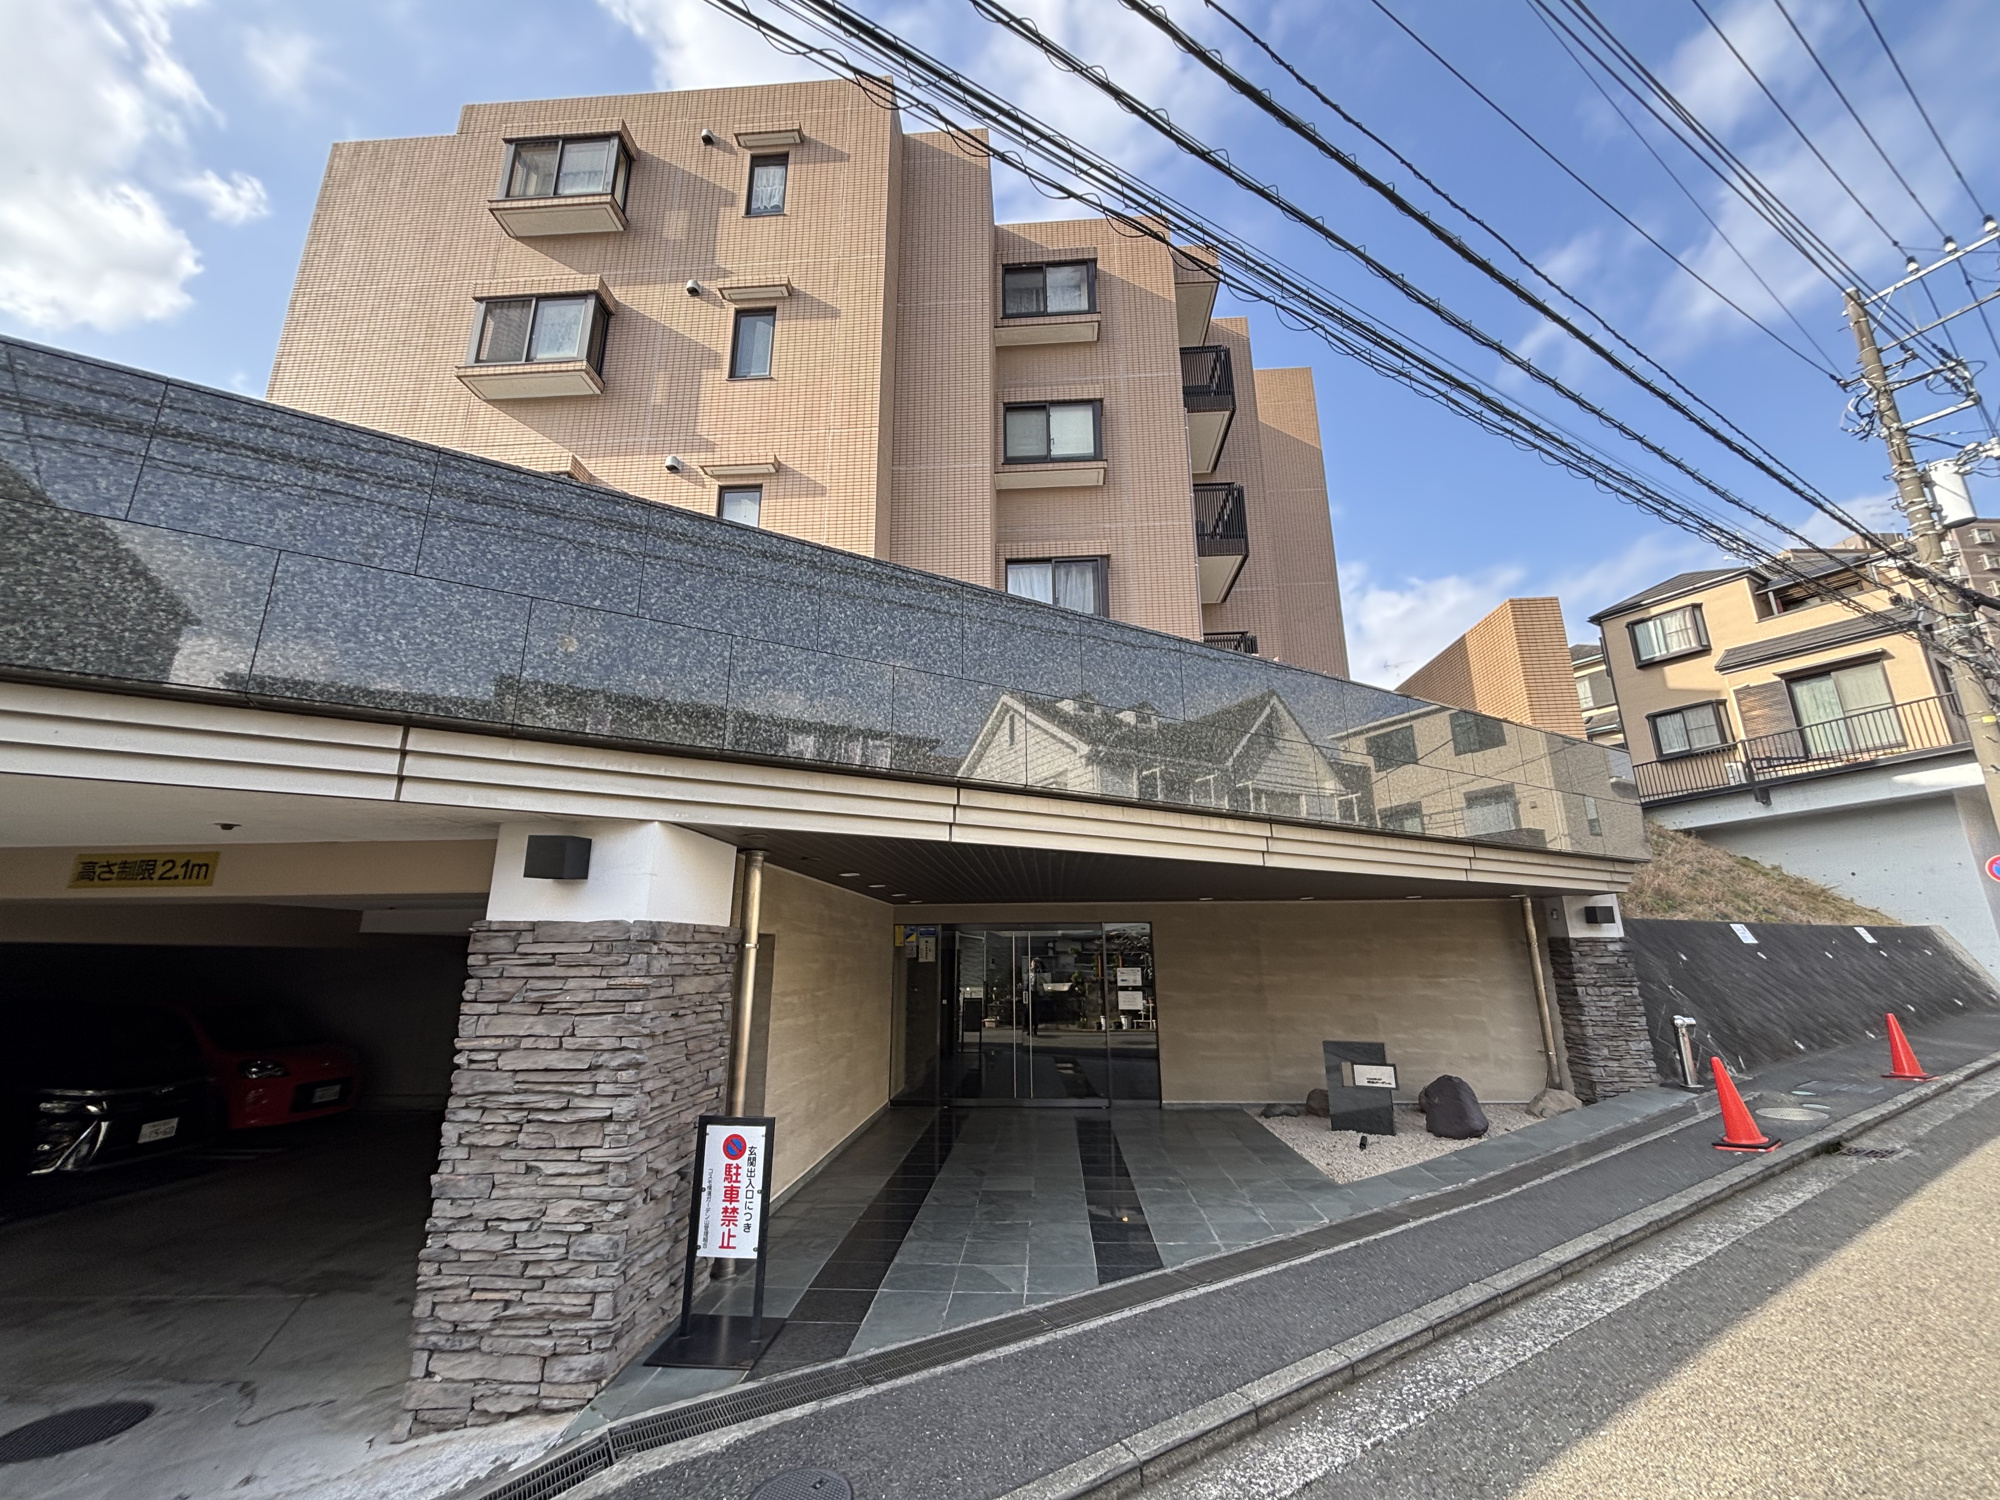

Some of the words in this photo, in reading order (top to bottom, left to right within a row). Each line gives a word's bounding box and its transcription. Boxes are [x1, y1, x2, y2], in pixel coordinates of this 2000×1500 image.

[718, 1163, 742, 1250] 駐車禁止
[743, 1145, 757, 1233] 玄関出入口につき
